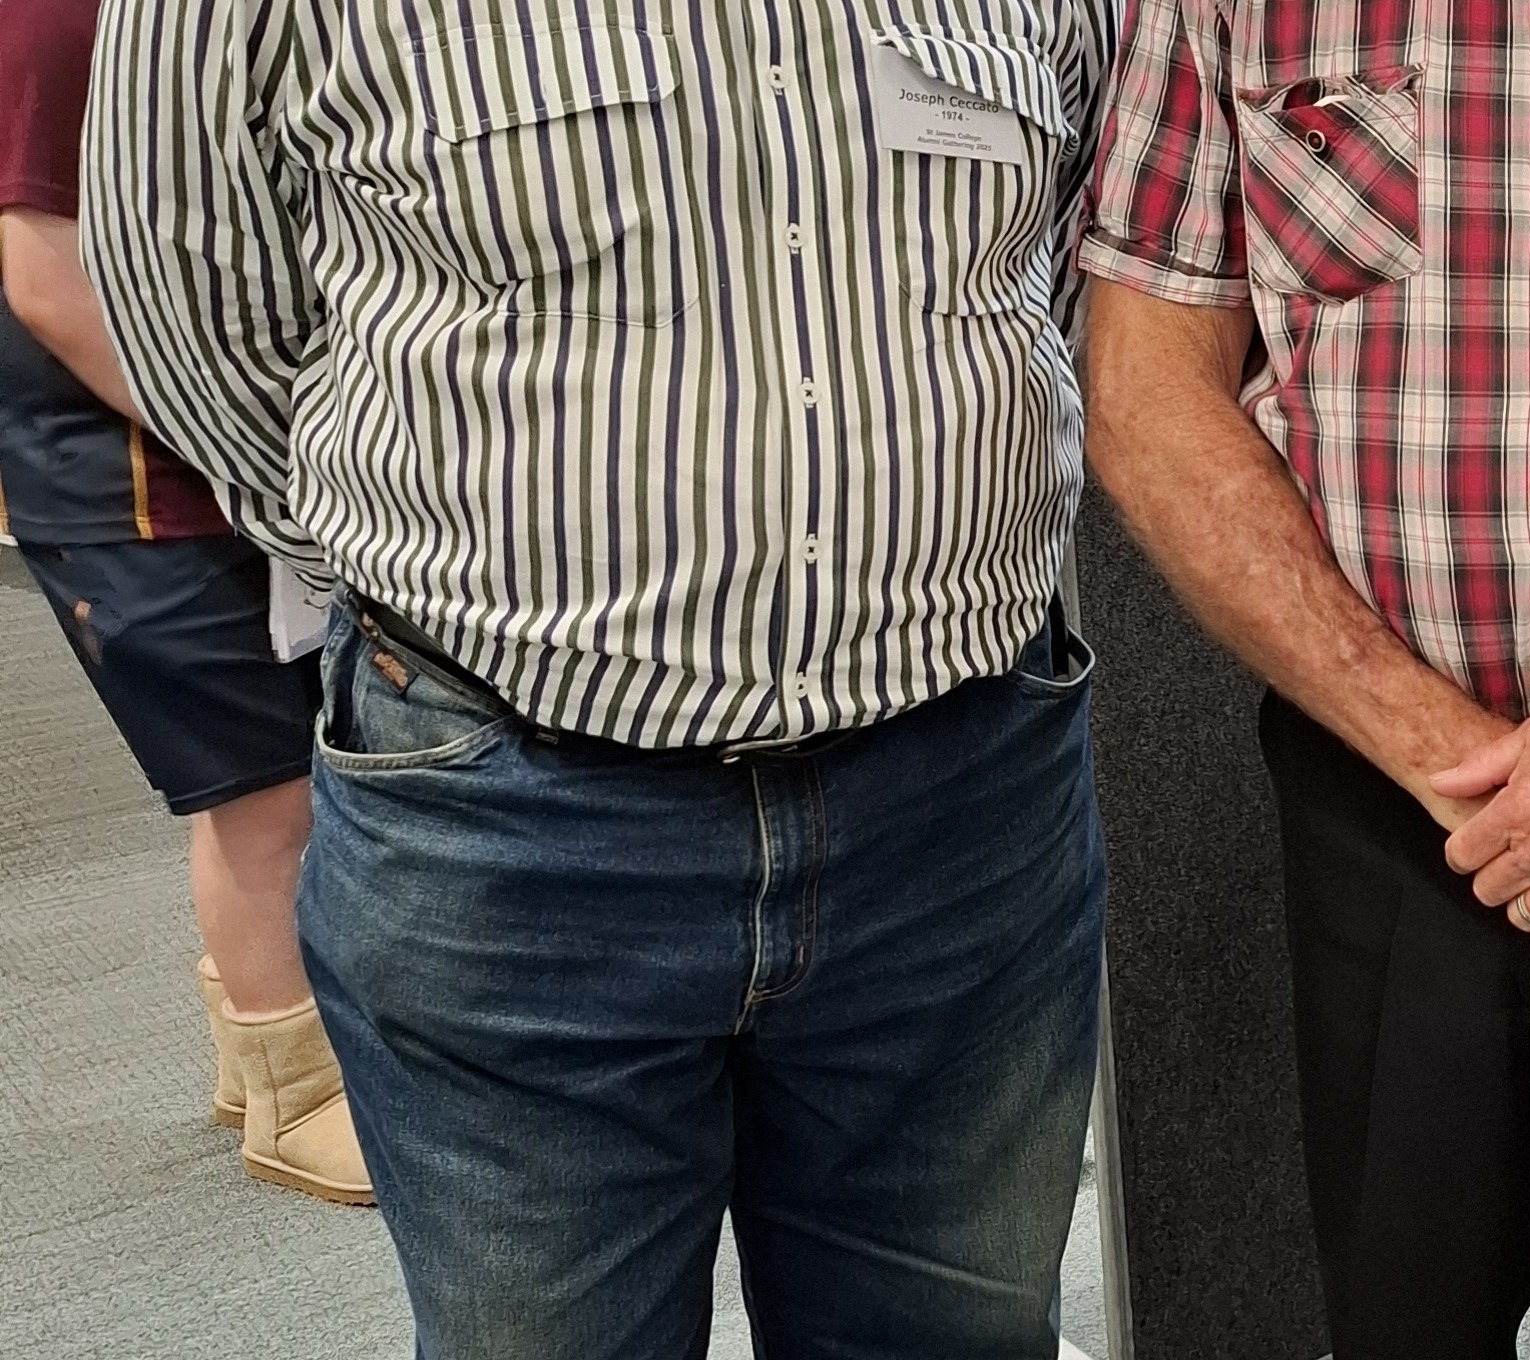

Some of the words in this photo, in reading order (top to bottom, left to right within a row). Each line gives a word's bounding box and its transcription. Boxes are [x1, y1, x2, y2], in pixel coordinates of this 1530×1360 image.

[899, 89, 945, 106] Joseph
[949, 96, 999, 113] Ceccato
[941, 111, 964, 121] 1974
